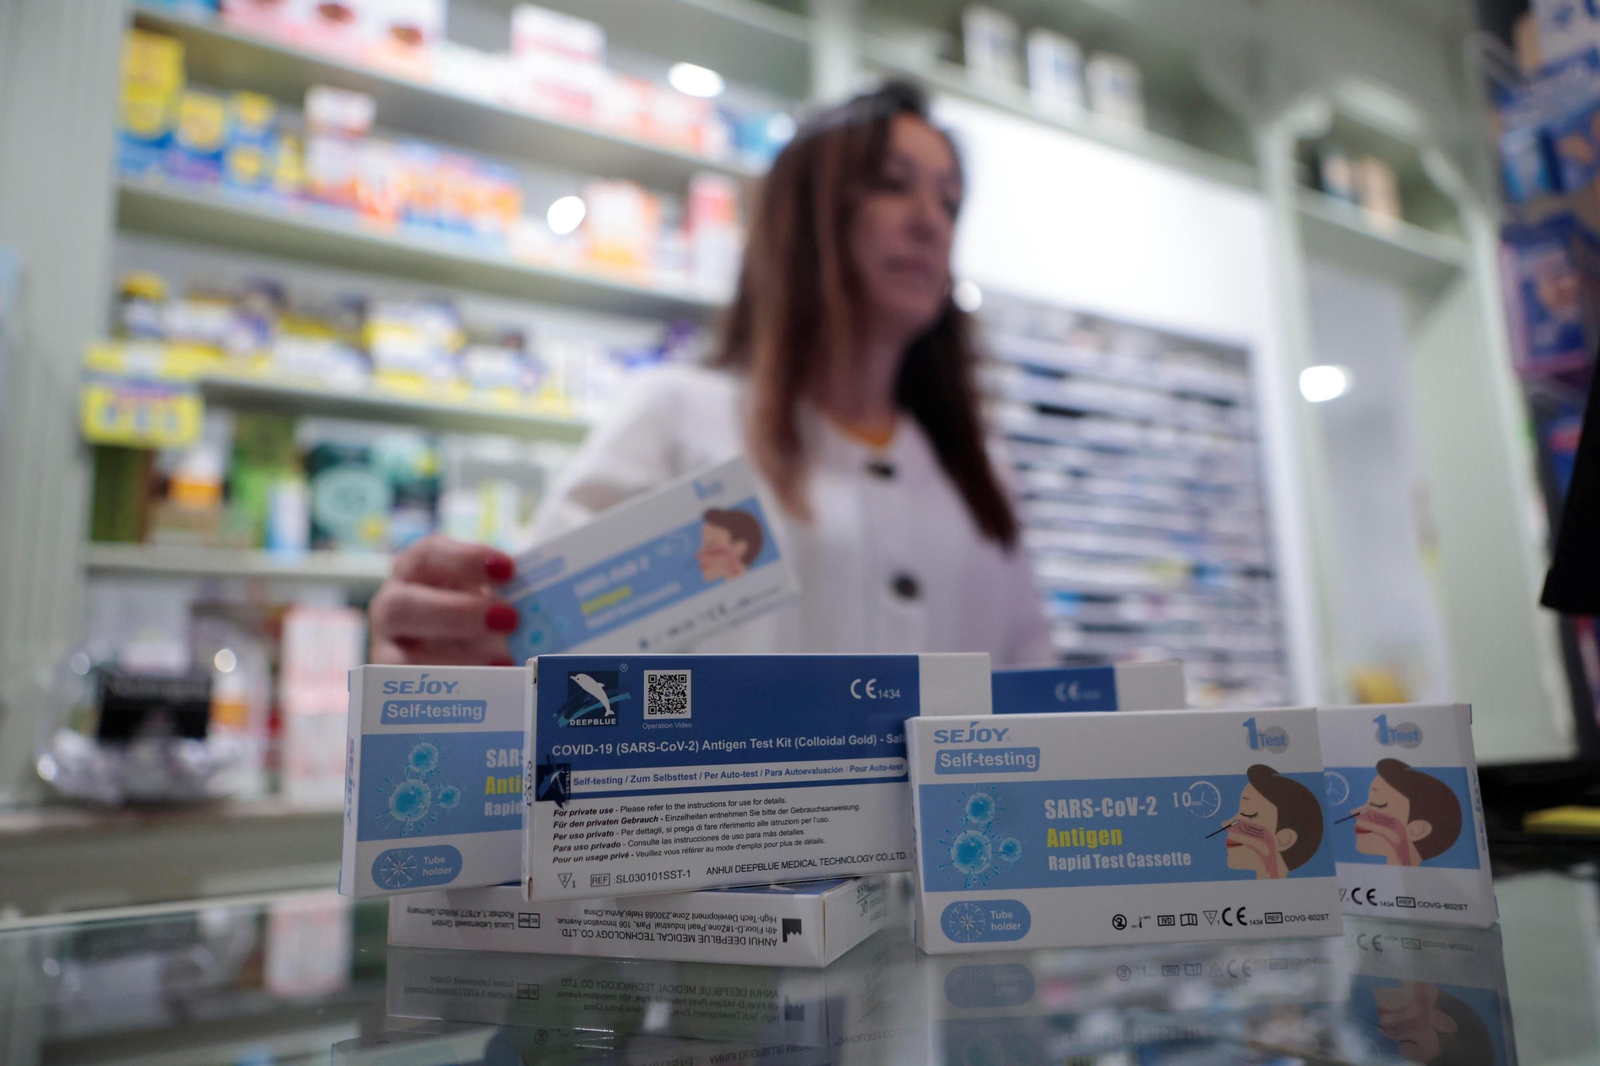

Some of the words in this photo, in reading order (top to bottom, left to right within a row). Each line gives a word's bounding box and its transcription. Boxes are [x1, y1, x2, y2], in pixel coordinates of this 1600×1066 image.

[382, 673, 460, 694] SEJOY
[878, 689, 901, 699] 1434
[386, 703, 483, 721] Self-testing
[569, 718, 617, 726] DEEPBLUE
[674, 721, 692, 729] Video
[933, 721, 1010, 744] SEJOY
[552, 743, 613, 756] COVID-19
[616, 740, 699, 756] (SARS-CoV-2)
[702, 739, 746, 752] Antigen
[750, 738, 773, 748] Test
[776, 737, 792, 748] Kit
[794, 735, 846, 750] (Colloidal
[848, 734, 877, 747] Gold)
[940, 752, 1036, 768] Self-testing
[573, 776, 623, 787] Self-testing
[630, 774, 650, 783] Zum
[652, 772, 697, 782] Selbsttest
[704, 772, 718, 780] Per
[720, 769, 758, 779] Auto-test
[764, 768, 783, 777] Para
[785, 766, 843, 776] Autoevaluación
[849, 765, 868, 773] Pour
[869, 763, 904, 772] Auto-test
[1172, 791, 1191, 809] 10
[553, 809, 567, 817] For
[569, 808, 597, 817] private
[620, 805, 645, 813] Please
[647, 803, 664, 812] refer
[674, 802, 685, 810] the
[687, 800, 726, 809] instructions
[728, 799, 737, 807] for
[753, 798, 762, 806] for
[763, 797, 787, 805] details.
[1045, 796, 1158, 819] SARS-CoV-2
[553, 821, 567, 829] Für
[586, 818, 618, 829] privaten
[620, 816, 659, 825] Gebrauch
[665, 813, 708, 822] Einzelheiten
[709, 810, 747, 819] entnehmen
[749, 809, 760, 817] Sie
[762, 808, 776, 816] bitte
[790, 804, 860, 814] Gebrauchsanweisung.
[585, 830, 614, 840] privato
[621, 828, 634, 836] Per
[636, 826, 664, 836] dettagli,
[673, 825, 694, 834] prega
[703, 823, 717, 831] fare
[719, 821, 755, 830] riferimento
[770, 818, 799, 826] istruzioni
[801, 818, 812, 826] per
[590, 841, 621, 852] privado
[627, 838, 660, 848] Consulte
[673, 835, 719, 844] instrucciones
[721, 833, 730, 841] de
[763, 829, 777, 838] más
[778, 828, 806, 836] detalles.
[1047, 828, 1122, 849] Antigen
[553, 856, 572, 864] Pour
[585, 854, 608, 863] usage
[610, 851, 630, 861] privé
[636, 849, 662, 858] Veuillez
[682, 846, 704, 855] référer
[716, 843, 734, 852] mode
[736, 842, 762, 851] d'emploi
[780, 840, 793, 848] plus
[803, 837, 826, 846] détails.
[422, 856, 446, 865] Tube
[706, 862, 733, 875] ANHUI
[734, 861, 780, 873] DEEPBLUE
[781, 859, 817, 869] MEDICAL
[819, 855, 874, 866] TECHNOLOGY
[1048, 855, 1090, 872] Rapid
[1092, 853, 1125, 869] Test
[1127, 852, 1191, 868] Cassette
[422, 866, 453, 877] holder
[592, 875, 609, 885] REF
[692, 912, 739, 922] Development
[740, 914, 777, 923] High-Tech
[990, 910, 1014, 919] Tube
[432, 919, 452, 928] GmbH
[455, 919, 492, 929] Lebenswelt
[494, 921, 514, 930] Luxus
[556, 917, 582, 926] Avenue,
[583, 918, 617, 928] Innovation
[618, 920, 631, 928] 106
[633, 921, 651, 929] Park,
[654, 922, 686, 931] Industrial
[991, 921, 1022, 931] holder
[596, 930, 655, 941] TECHNOLOGY
[656, 932, 696, 943] MEDICAL
[698, 934, 746, 945] DEEPBLUE
[749, 938, 777, 947] ANHUI
